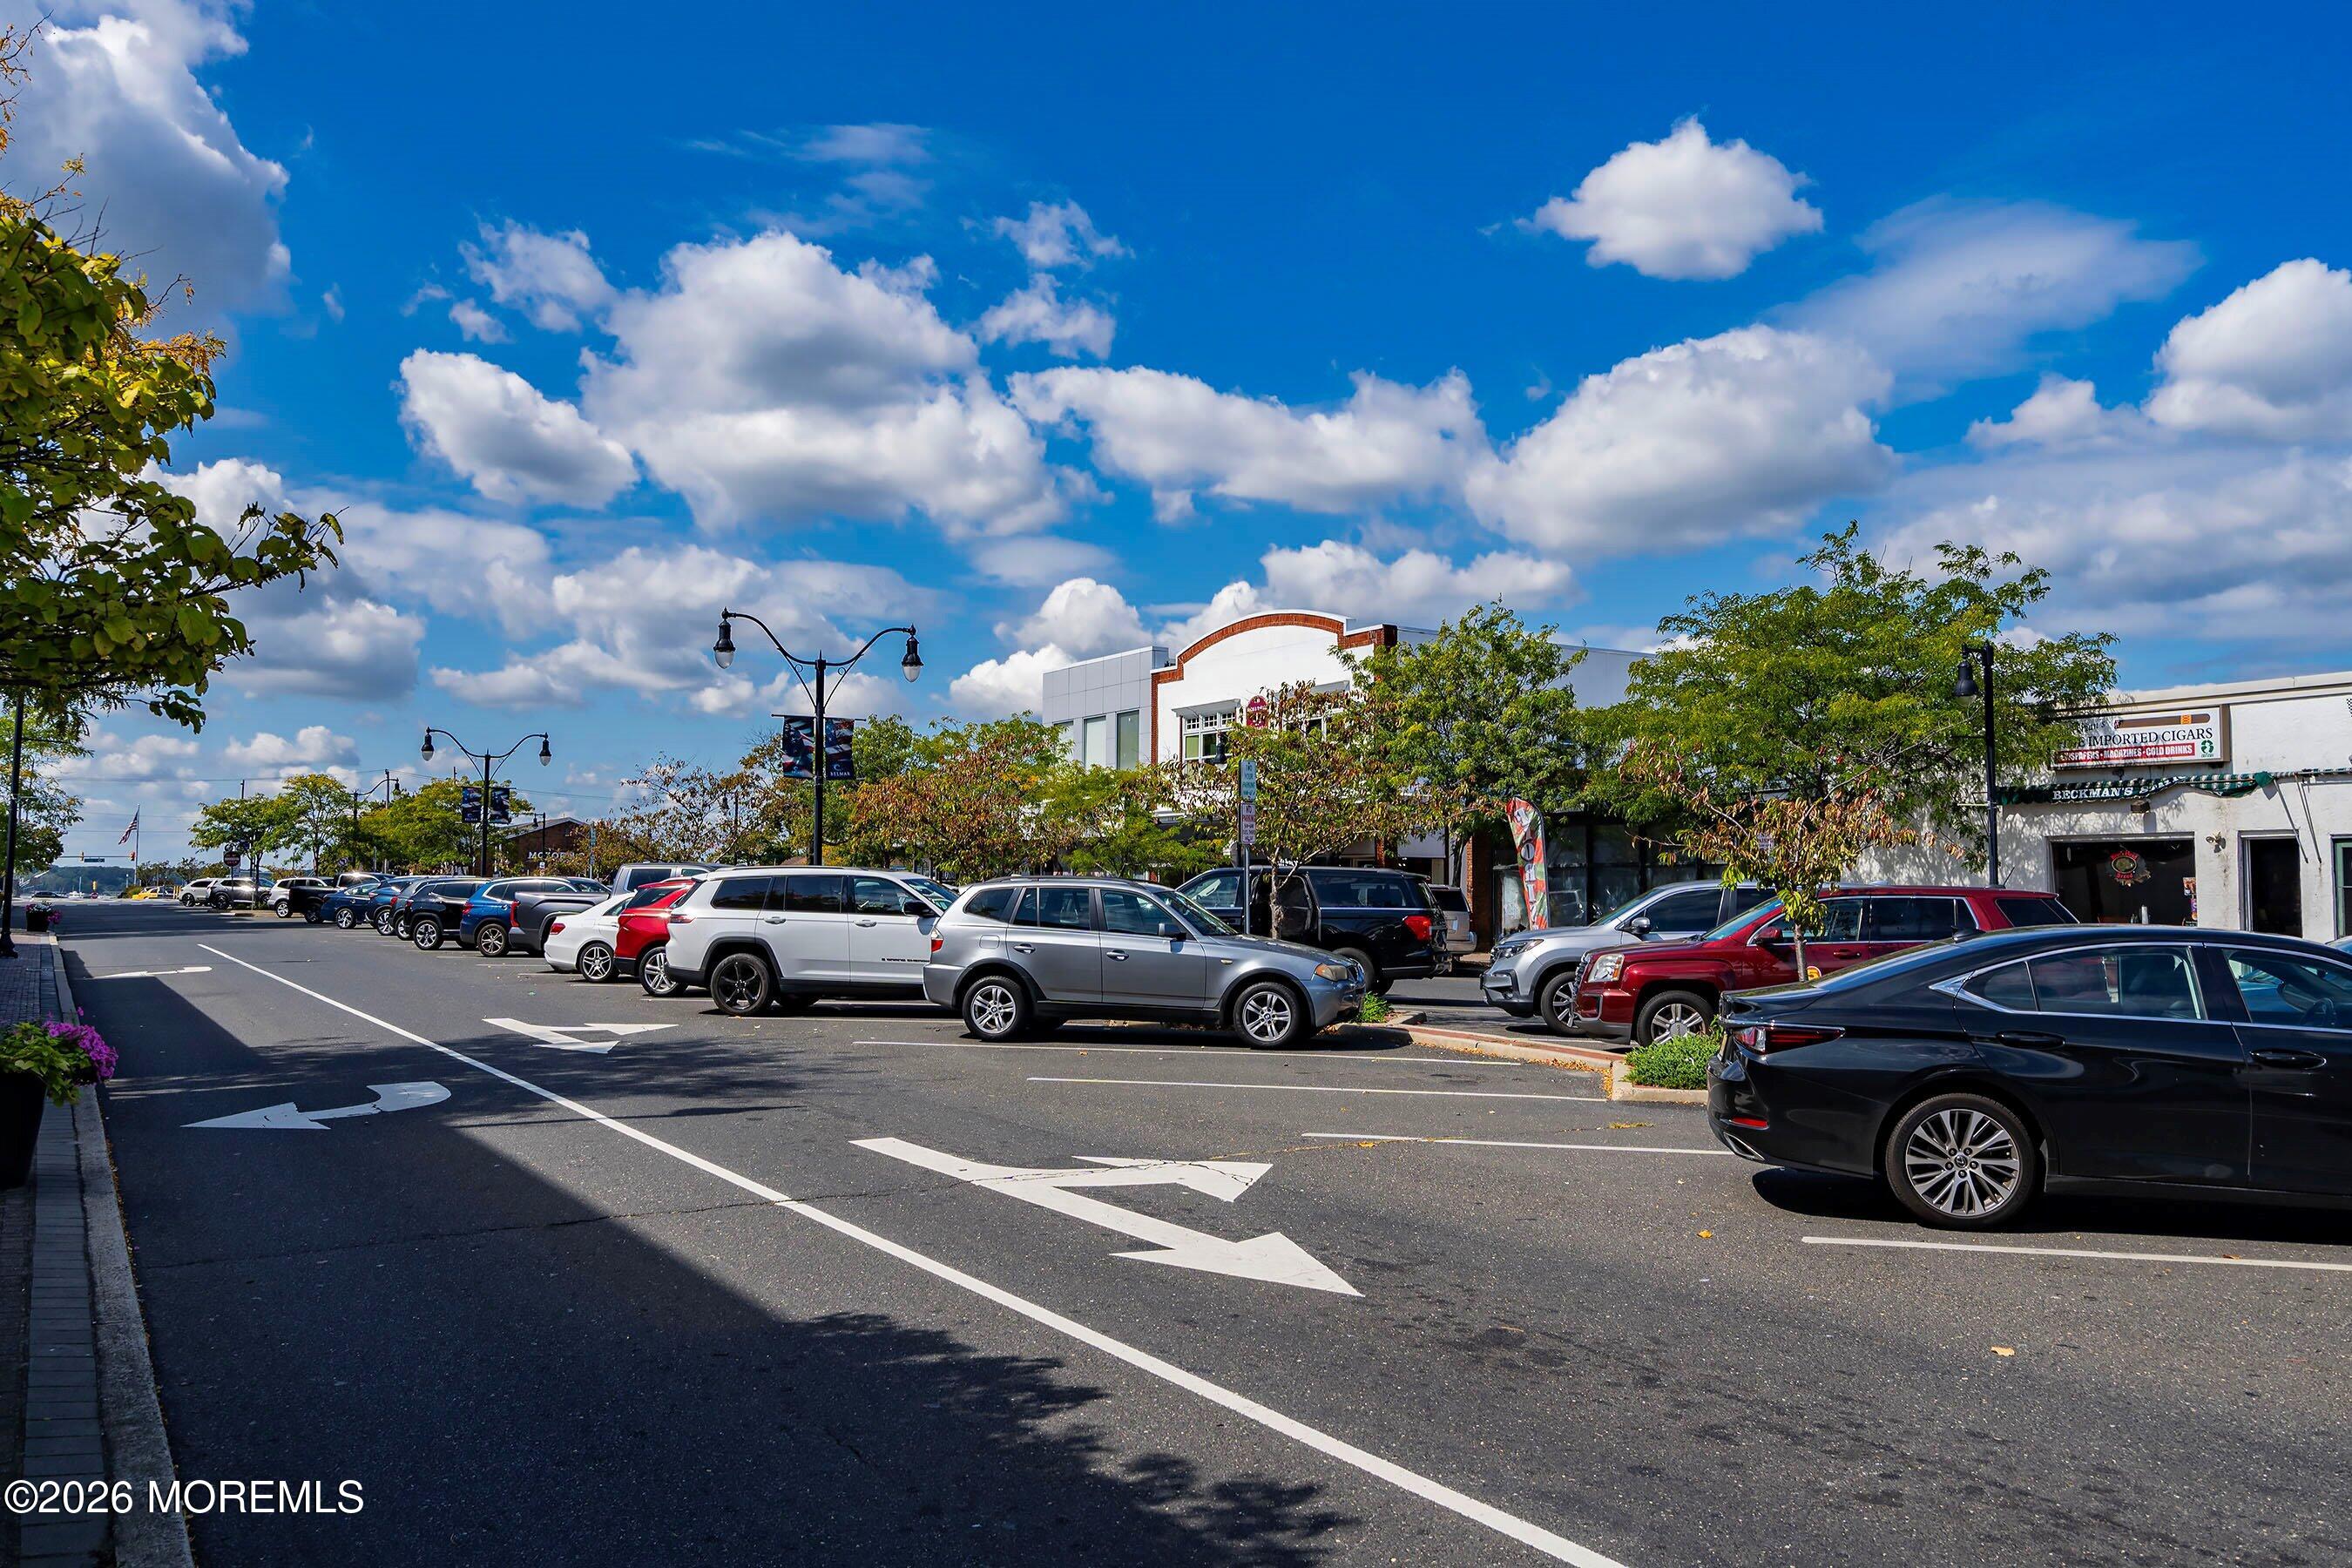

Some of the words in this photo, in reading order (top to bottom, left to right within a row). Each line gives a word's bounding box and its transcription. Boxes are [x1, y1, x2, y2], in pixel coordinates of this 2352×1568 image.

[2088, 731, 2159, 747] IMPORTED
[2161, 727, 2213, 742] CIGARS
[2059, 750, 2100, 761] WSPAPERS
[2104, 747, 2142, 759] MAGAZINES
[2146, 746, 2165, 756] COLD
[2165, 744, 2193, 755] DRINKS
[2052, 787, 2134, 801] BECKMAN'S
